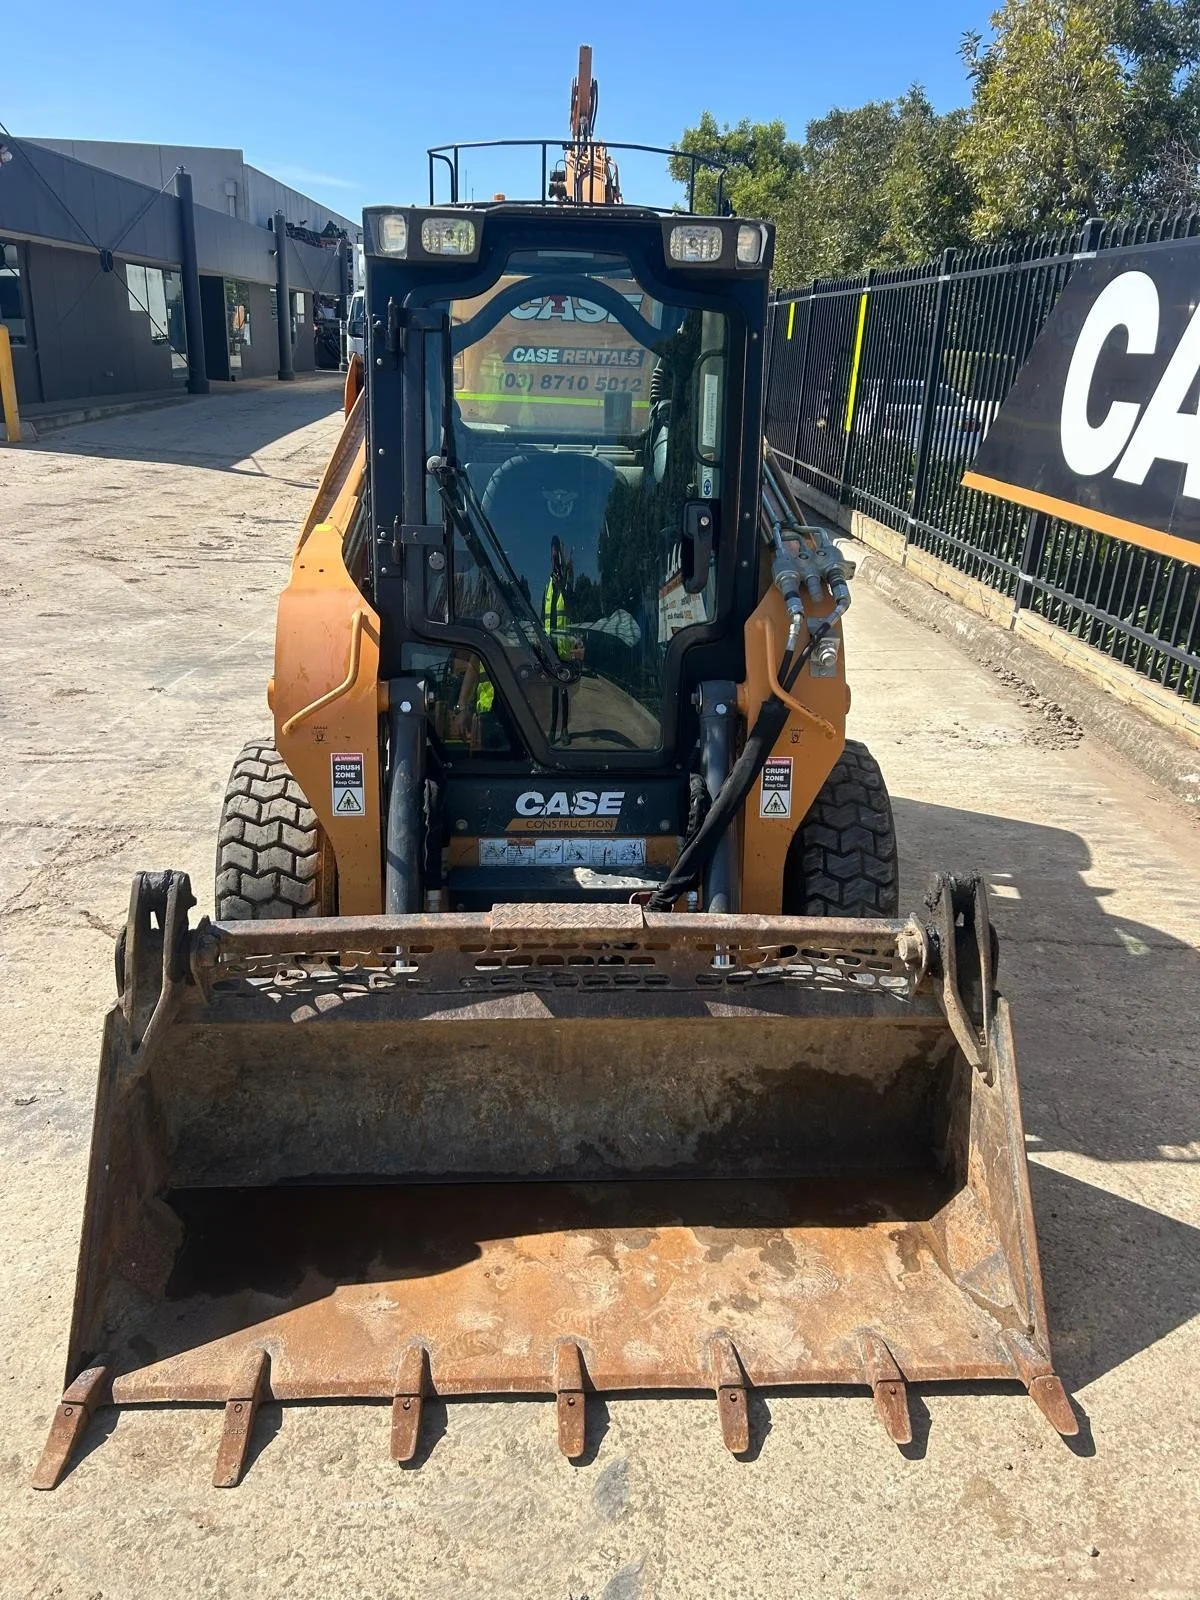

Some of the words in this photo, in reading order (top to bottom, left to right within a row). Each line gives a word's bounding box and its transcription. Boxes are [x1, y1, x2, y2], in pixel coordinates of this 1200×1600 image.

[512, 348, 560, 363] CASE
[562, 350, 640, 366] RENTALS
[498, 372, 533, 392] (03)
[540, 374, 588, 391] 8710
[594, 377, 642, 392] 5012
[515, 791, 625, 816] CASE
[526, 820, 614, 830] CONSTRUCTION
